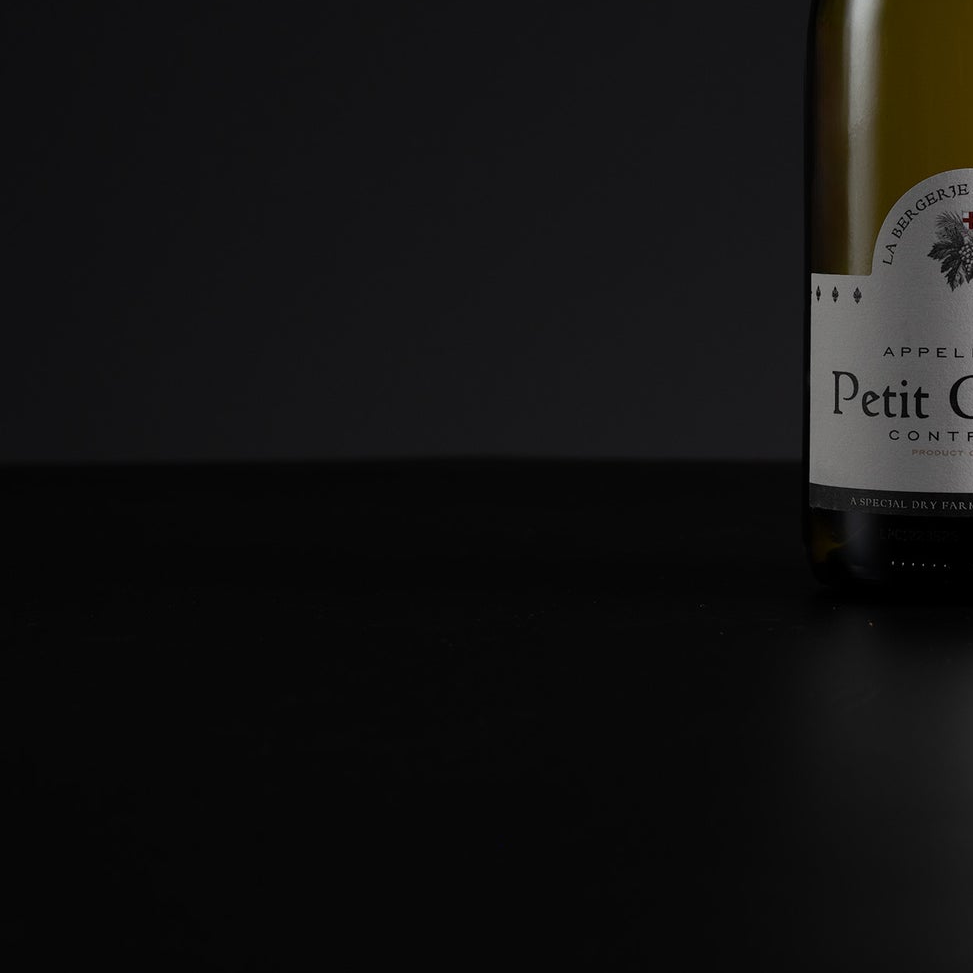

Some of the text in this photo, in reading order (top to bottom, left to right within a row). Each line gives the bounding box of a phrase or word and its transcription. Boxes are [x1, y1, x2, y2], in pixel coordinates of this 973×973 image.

[882, 243, 898, 266] LA
[832, 370, 930, 419] Petit
[911, 449, 964, 457] PRODUCT
[849, 497, 858, 508] A
[911, 500, 938, 511] DRY
